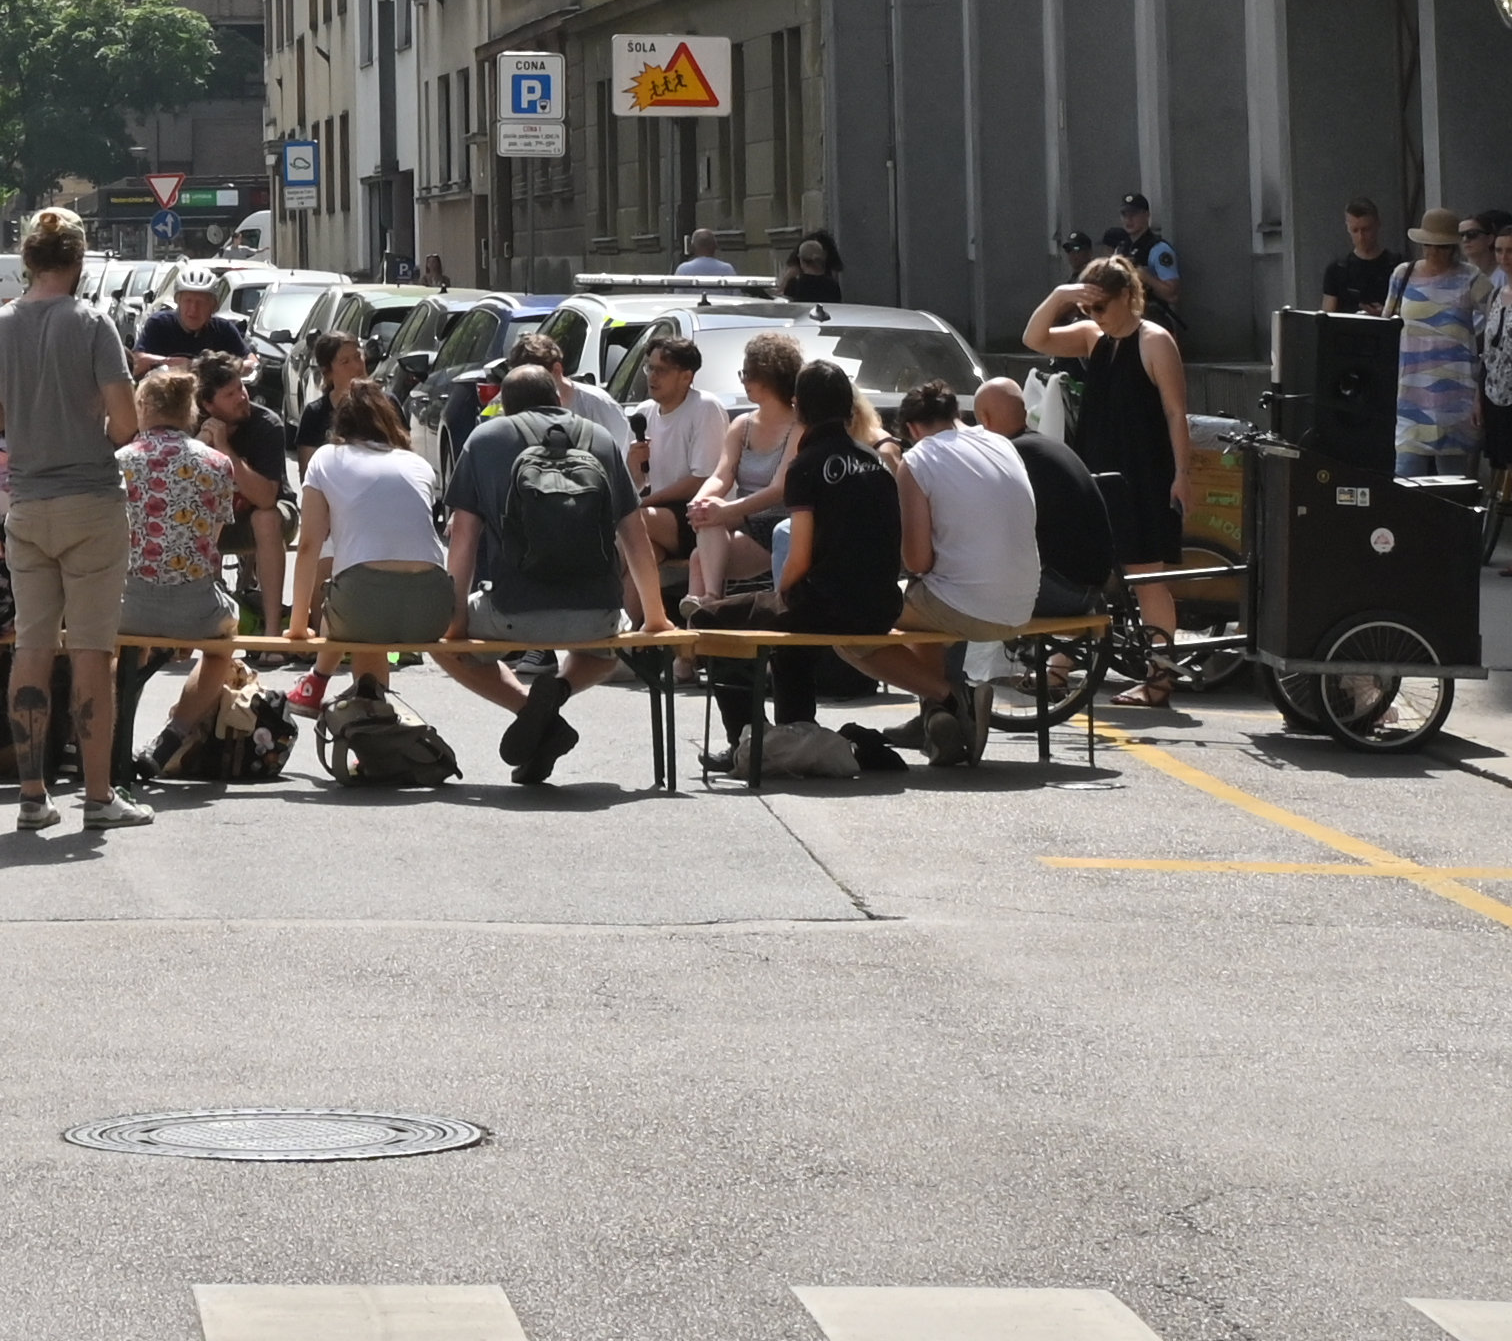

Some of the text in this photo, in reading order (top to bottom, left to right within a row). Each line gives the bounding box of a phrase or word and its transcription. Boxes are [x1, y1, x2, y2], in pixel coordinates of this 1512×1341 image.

[627, 39, 656, 52] ŠOLA
[516, 60, 546, 70] CONA
[521, 79, 542, 109] P
